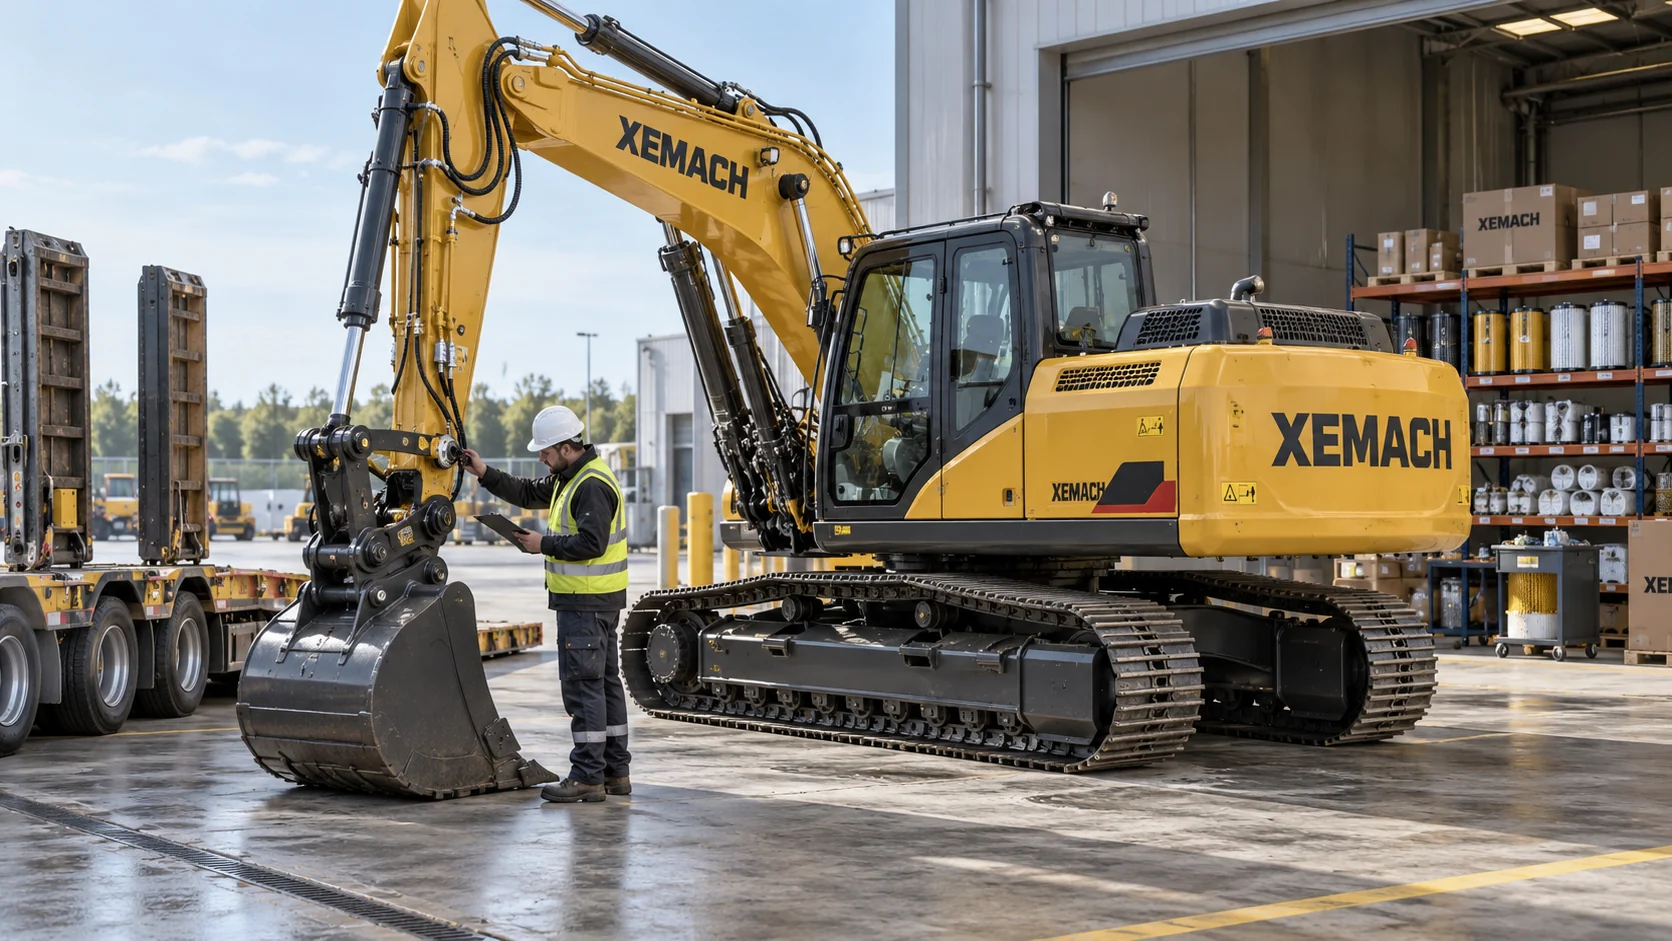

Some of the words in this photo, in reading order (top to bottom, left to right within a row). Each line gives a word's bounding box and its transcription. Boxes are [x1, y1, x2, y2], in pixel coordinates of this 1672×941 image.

[616, 115, 749, 199] XEMACH
[1478, 212, 1540, 231] XEMACH
[1271, 413, 1452, 469] XEMACH
[1052, 482, 1105, 501] XEMACH
[1644, 576, 1672, 593] XE
